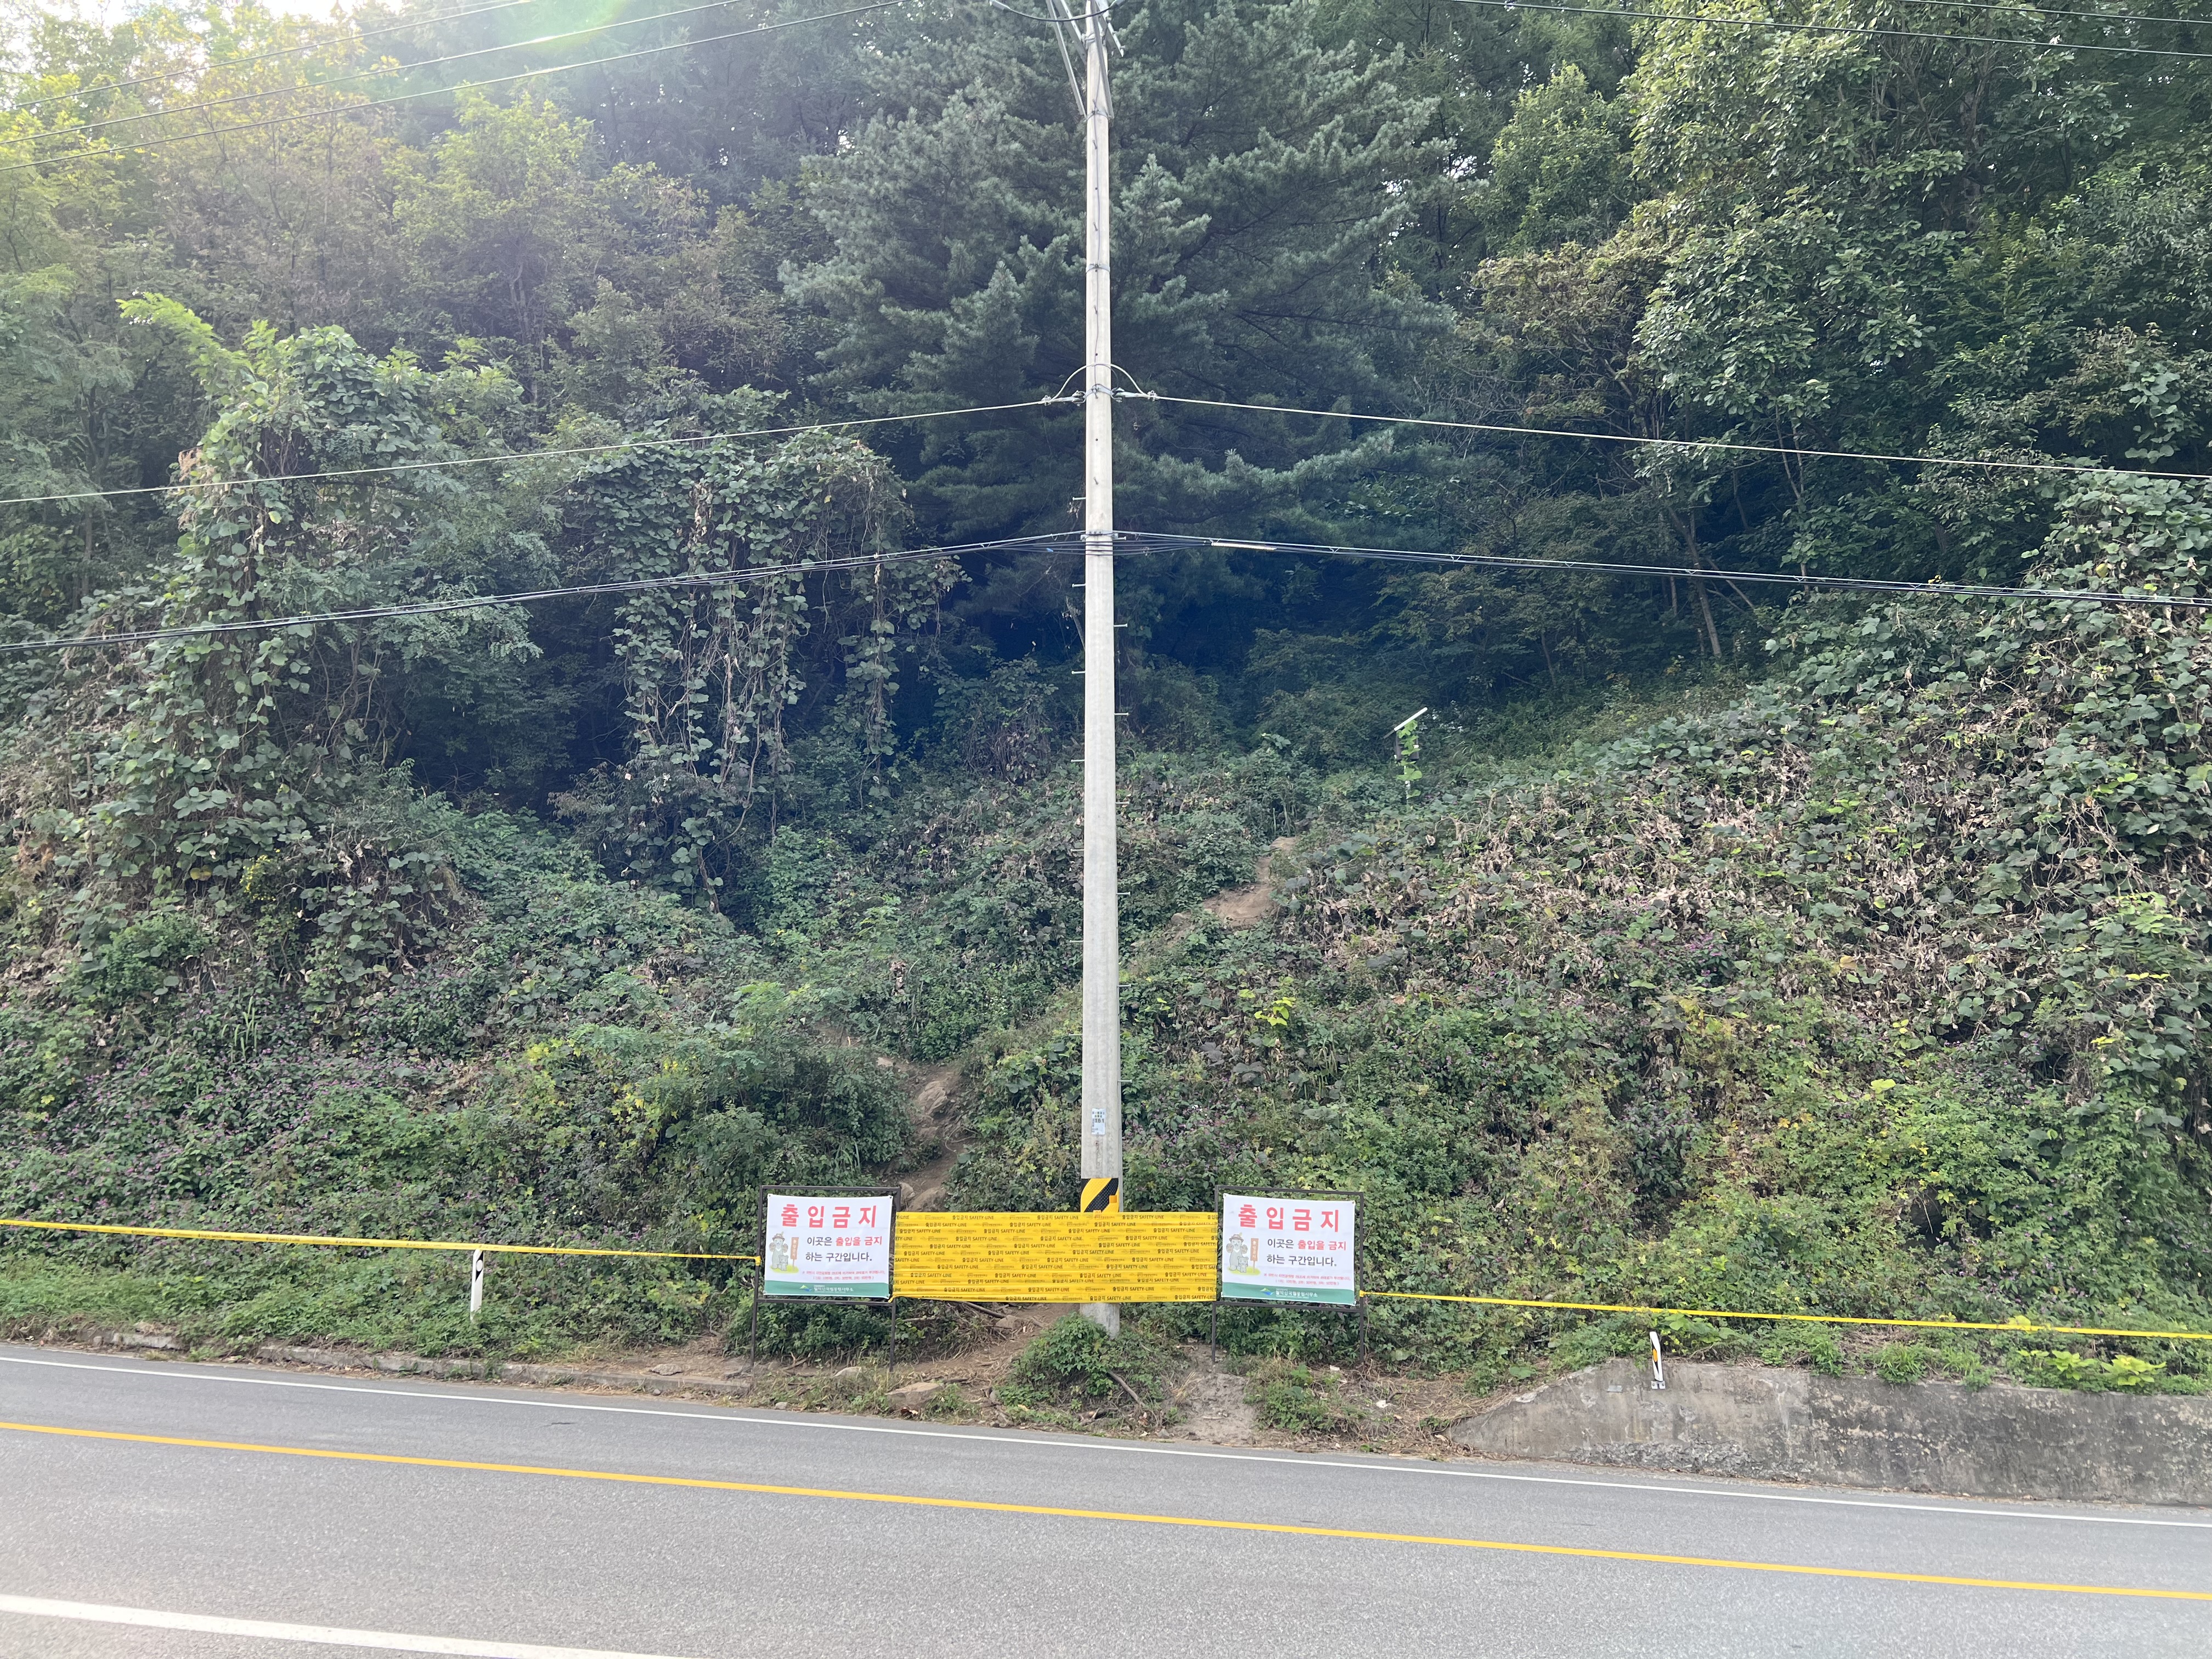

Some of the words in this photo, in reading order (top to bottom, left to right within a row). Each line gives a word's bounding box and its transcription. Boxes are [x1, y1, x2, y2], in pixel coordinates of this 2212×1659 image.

[781, 1204, 877, 1228] 출입금지
[1238, 1204, 1339, 1232] 출입금지
[807, 1237, 832, 1246] 이곳은
[835, 1236, 861, 1246] 출입을
[864, 1236, 882, 1246] 금지
[1267, 1238, 1294, 1249] 이곳은
[1297, 1240, 1325, 1250] 출입을
[1328, 1241, 1346, 1251] 금지
[805, 1252, 823, 1262] 하는
[825, 1252, 872, 1262] 구간입니다.
[1267, 1255, 1285, 1264] 하는
[1288, 1256, 1337, 1267] 구간입니다.
